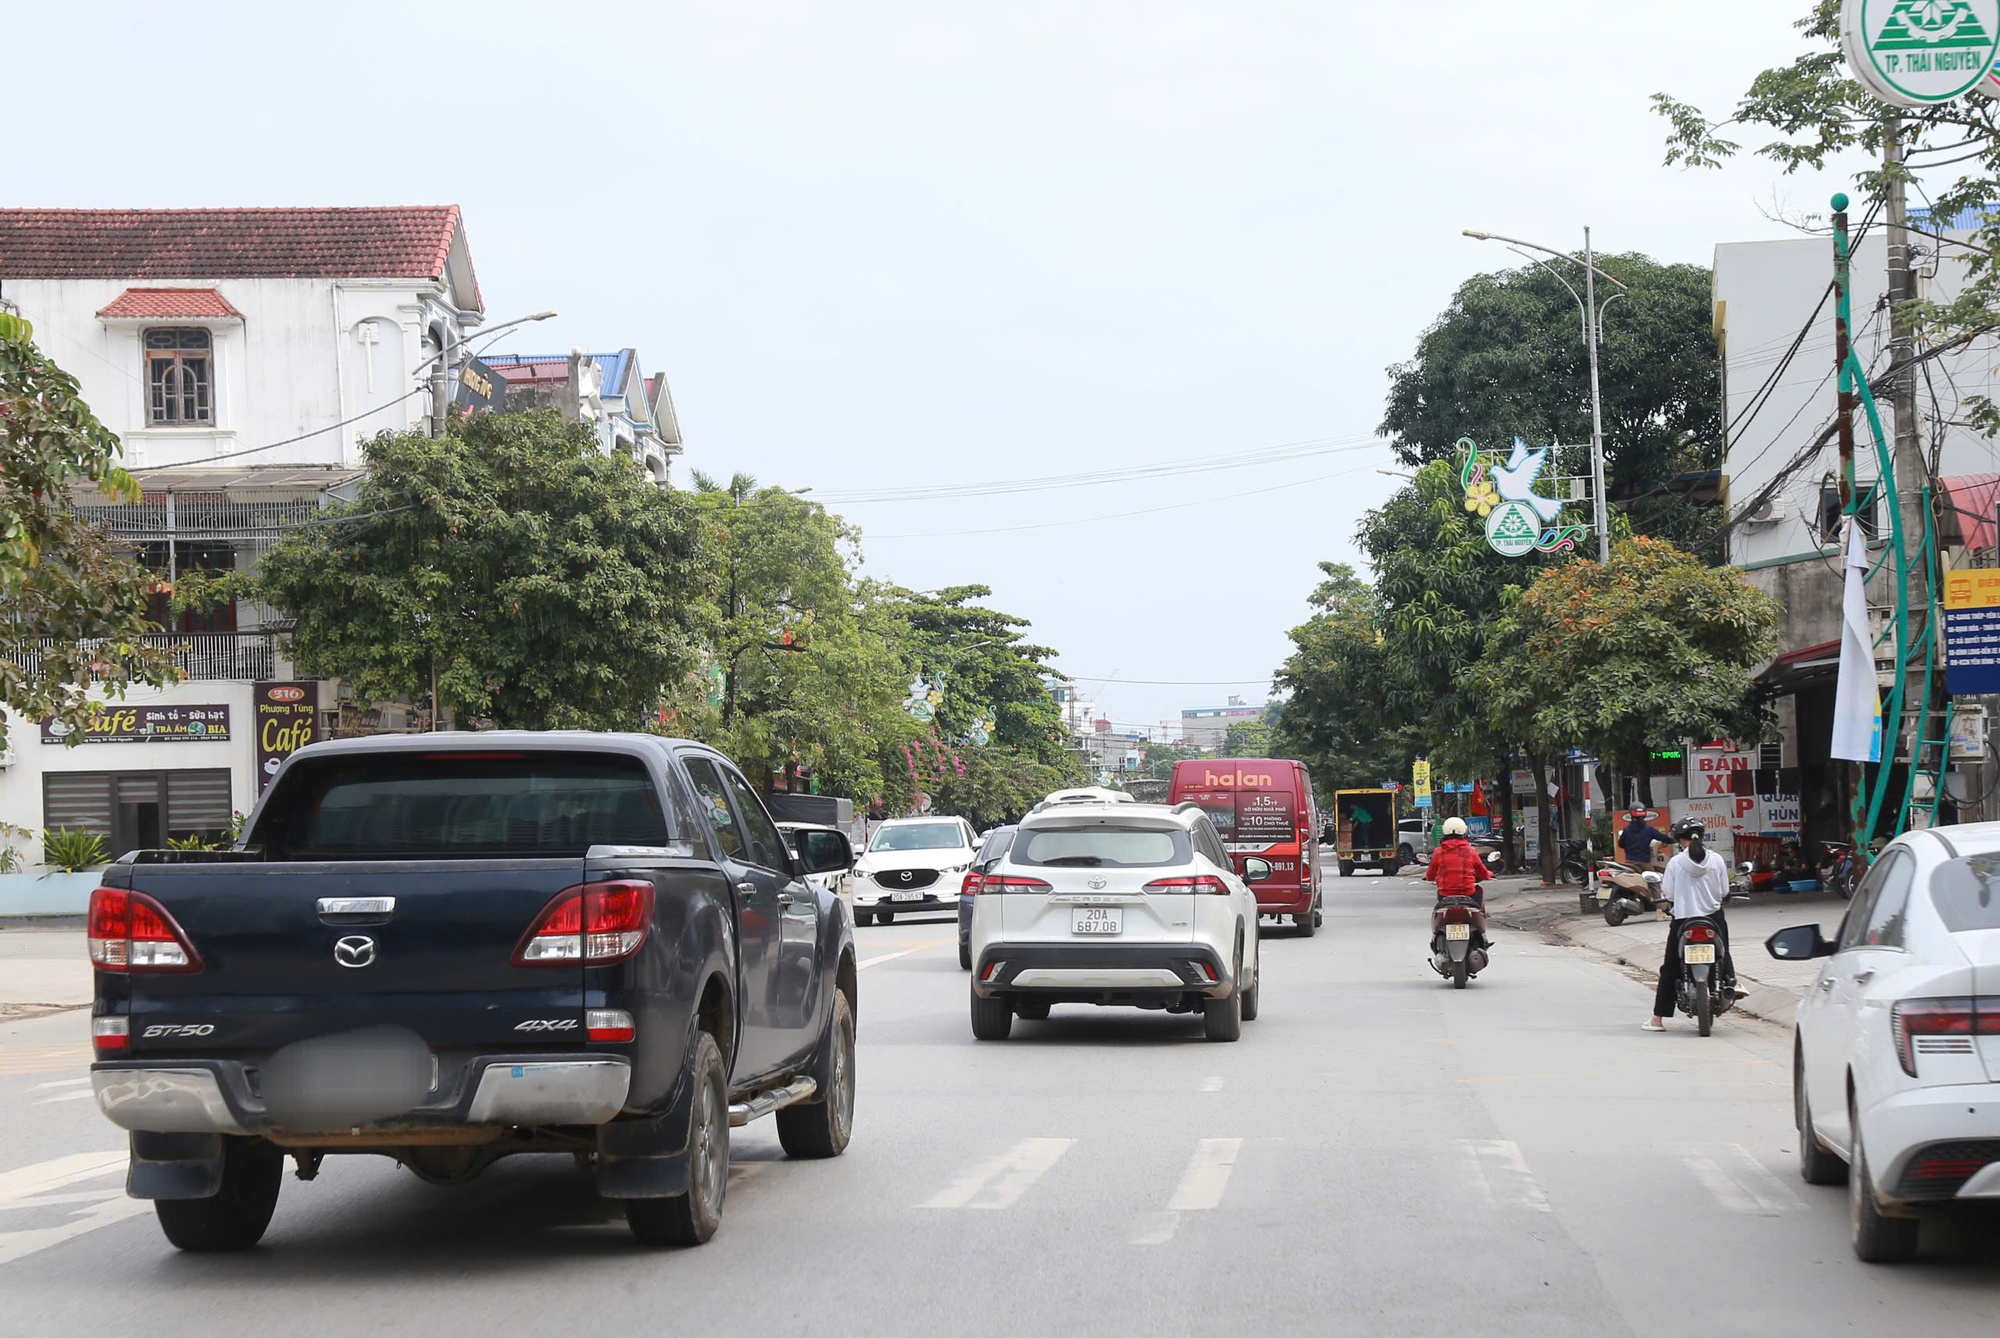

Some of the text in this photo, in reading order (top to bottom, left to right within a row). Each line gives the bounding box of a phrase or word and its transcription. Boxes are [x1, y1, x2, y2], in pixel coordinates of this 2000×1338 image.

[1885, 48, 1981, 73] TP. THÁI NGUYÊN
[273, 690, 299, 698] 316
[293, 704, 313, 713] Tùng
[146, 712, 165, 720] Sinh
[189, 710, 206, 720] Sữa
[208, 711, 225, 721] hạt
[155, 724, 172, 733] TRÀ
[208, 724, 227, 733] BIA
[262, 718, 312, 753] Café
[1699, 755, 1747, 771] BÁN
[1205, 769, 1272, 786] halan
[1769, 806, 1799, 820] HÙN
[1250, 816, 1262, 825] 10
[1087, 909, 1108, 920] 20A
[1077, 921, 1117, 932] 687.08
[142, 1024, 215, 1038] BT-50
